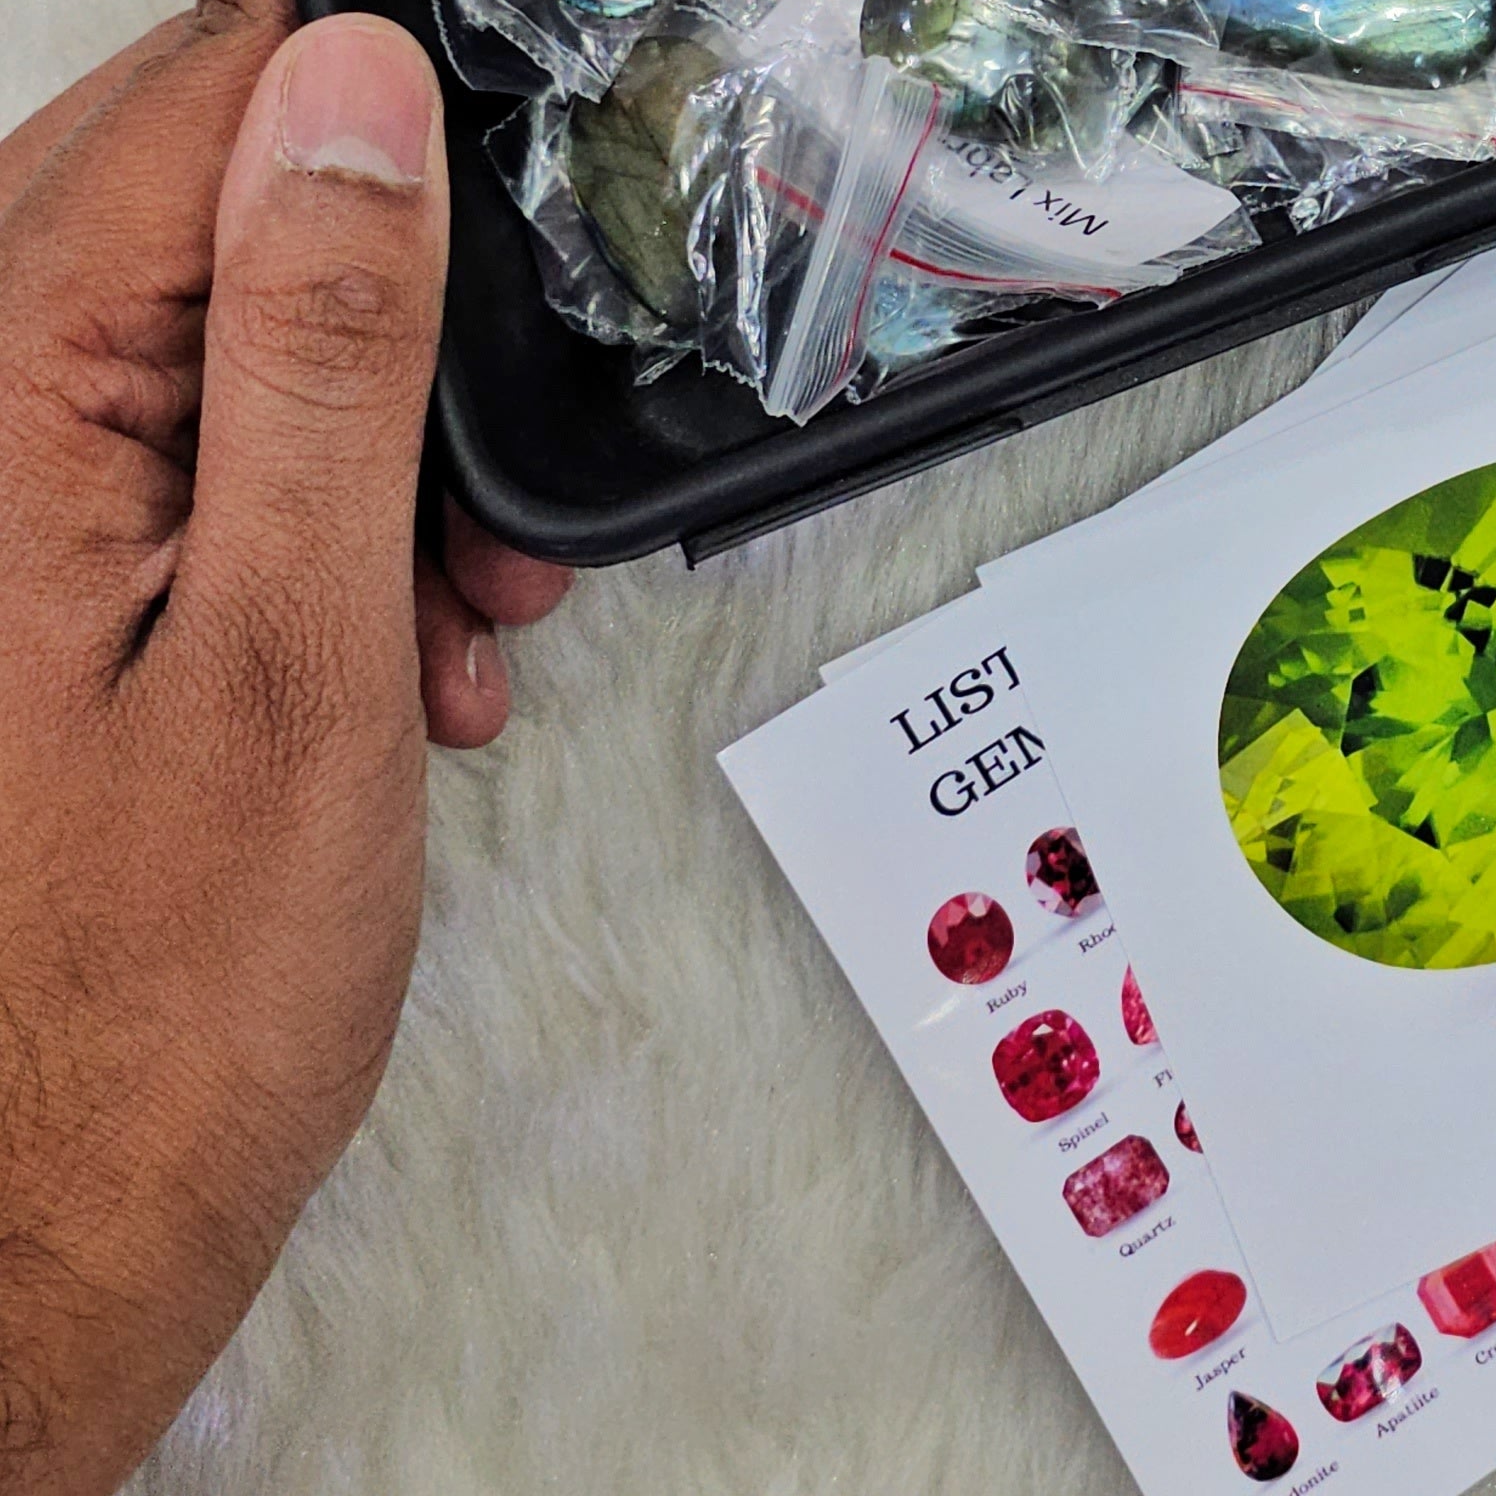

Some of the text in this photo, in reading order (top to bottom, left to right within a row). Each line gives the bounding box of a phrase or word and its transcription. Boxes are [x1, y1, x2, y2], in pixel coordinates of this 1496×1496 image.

[1033, 190, 1109, 236] Mix
[889, 645, 1021, 756] LIST
[985, 979, 1028, 1014] Ruby
[1058, 1110, 1110, 1154] Spinel
[1118, 1215, 1177, 1258] Quartz
[1194, 1346, 1247, 1392] Jasper
